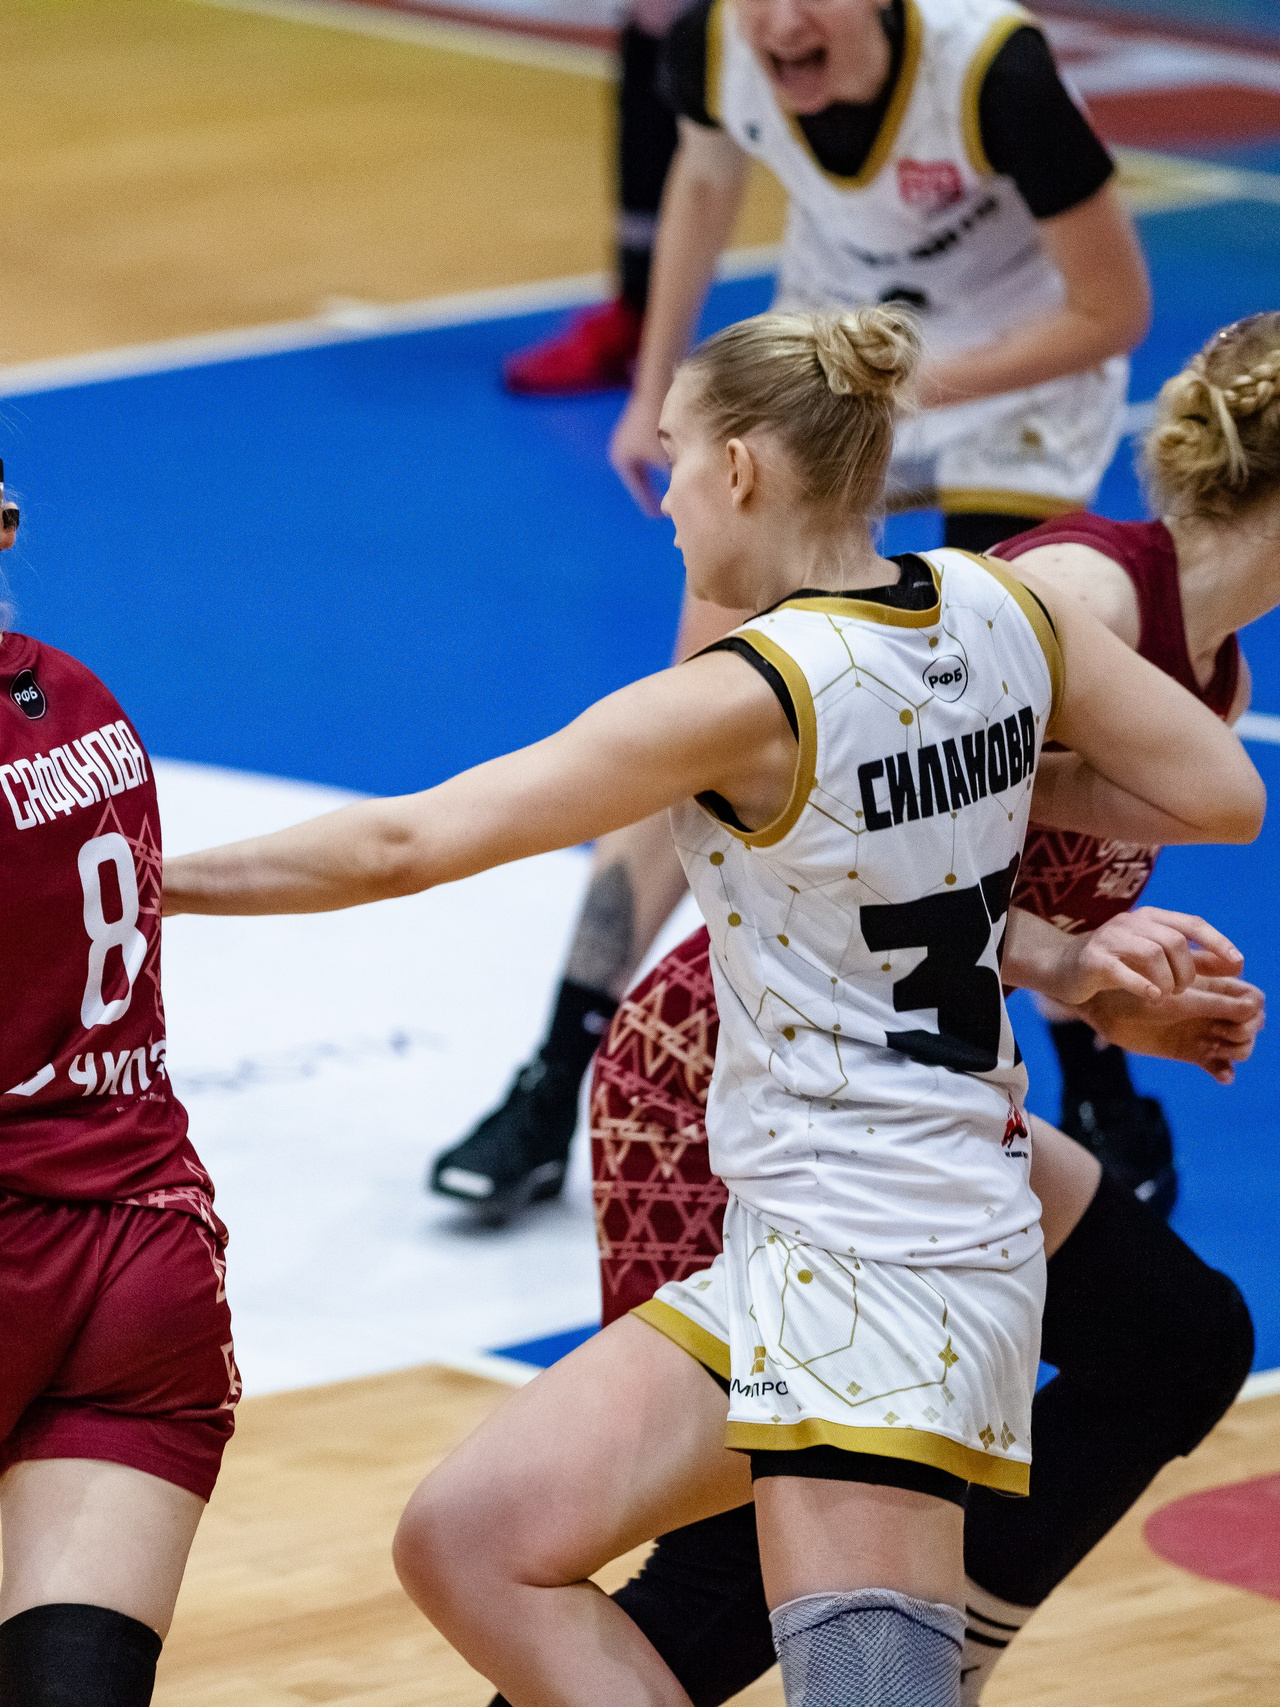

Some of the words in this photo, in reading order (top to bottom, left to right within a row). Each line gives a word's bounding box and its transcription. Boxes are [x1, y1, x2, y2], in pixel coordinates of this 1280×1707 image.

[13, 685, 38, 706] РФБ
[928, 667, 963, 689] РФБ
[857, 705, 1036, 832] СИЛАНОВА
[77, 831, 148, 1030] 8
